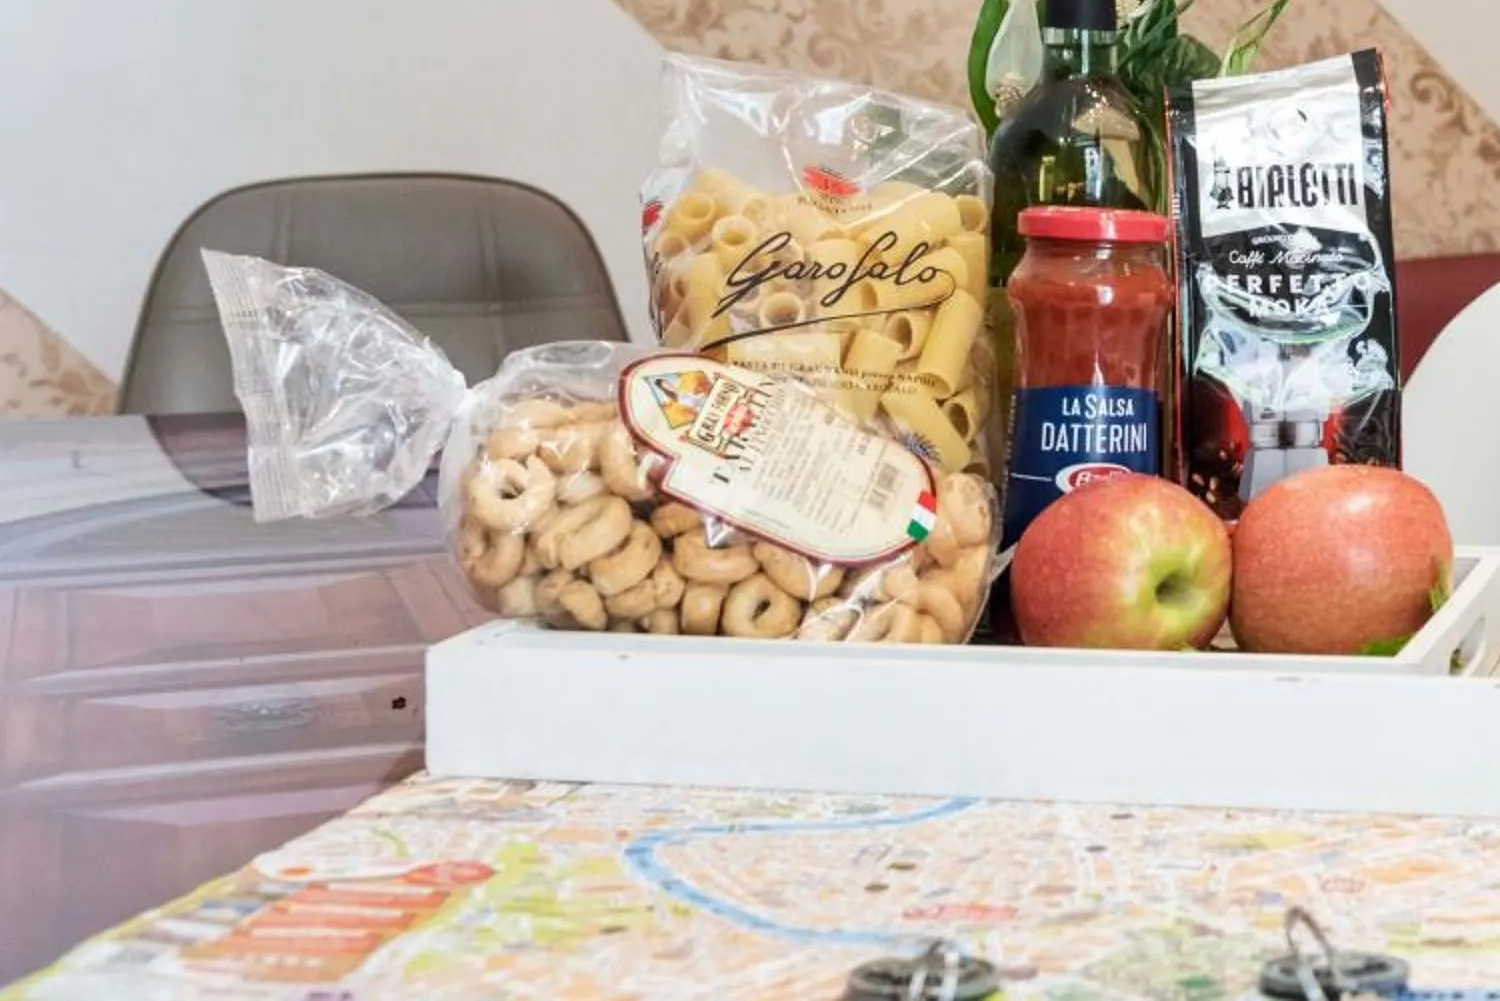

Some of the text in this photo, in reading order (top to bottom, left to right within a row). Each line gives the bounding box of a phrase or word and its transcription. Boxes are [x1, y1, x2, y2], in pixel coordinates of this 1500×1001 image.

[1237, 161, 1358, 210] BIALETTI
[711, 230, 957, 319] Garofalo
[1062, 397, 1081, 416] LA
[1041, 421, 1148, 454] DATTERINI
